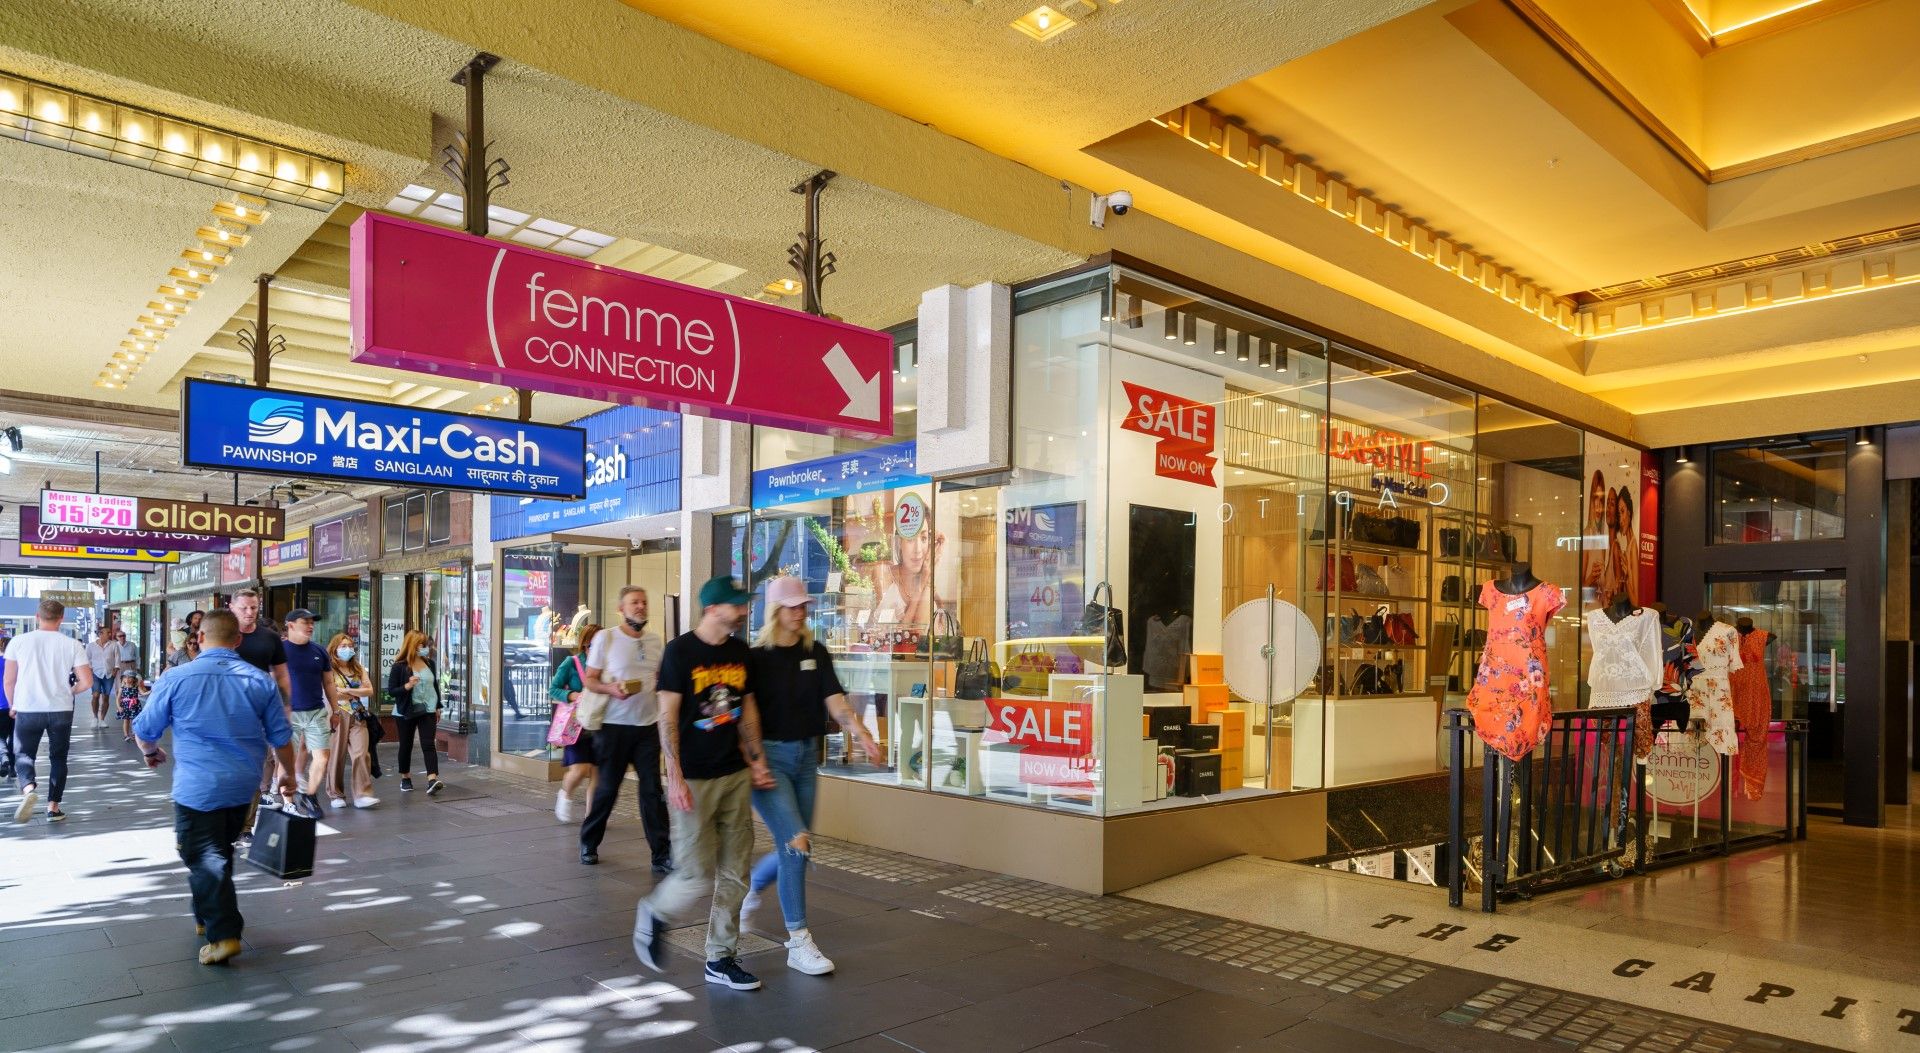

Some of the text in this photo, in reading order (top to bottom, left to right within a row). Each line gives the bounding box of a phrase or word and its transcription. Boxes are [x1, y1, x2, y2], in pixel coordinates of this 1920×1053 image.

[526, 271, 716, 356] femme
[525, 336, 716, 393] CONNECTION
[1137, 393, 1208, 445] SALE
[315, 407, 540, 467] Maxi-Cash
[223, 444, 318, 465] PAWNSHOP
[332, 455, 359, 469] 當店
[1158, 453, 1206, 477] NOW ON
[374, 459, 453, 478] SANGLAAN
[841, 459, 860, 475] 买卖
[466, 467, 560, 490] साहूकार की दुकान
[768, 467, 823, 489] Pawnbroker
[48, 492, 78, 502] Mens
[99, 496, 132, 507] Ladies
[48, 503, 84, 523] $15
[91, 506, 132, 527] $20
[145, 503, 276, 535] aliahair
[528, 574, 547, 590] SALE
[999, 705, 1082, 746] SALE
[1024, 760, 1082, 780] NOW ON
[1648, 753, 1710, 769] emme
[1199, 770, 1214, 778] CHANEL
[1371, 913, 1520, 953] THE
